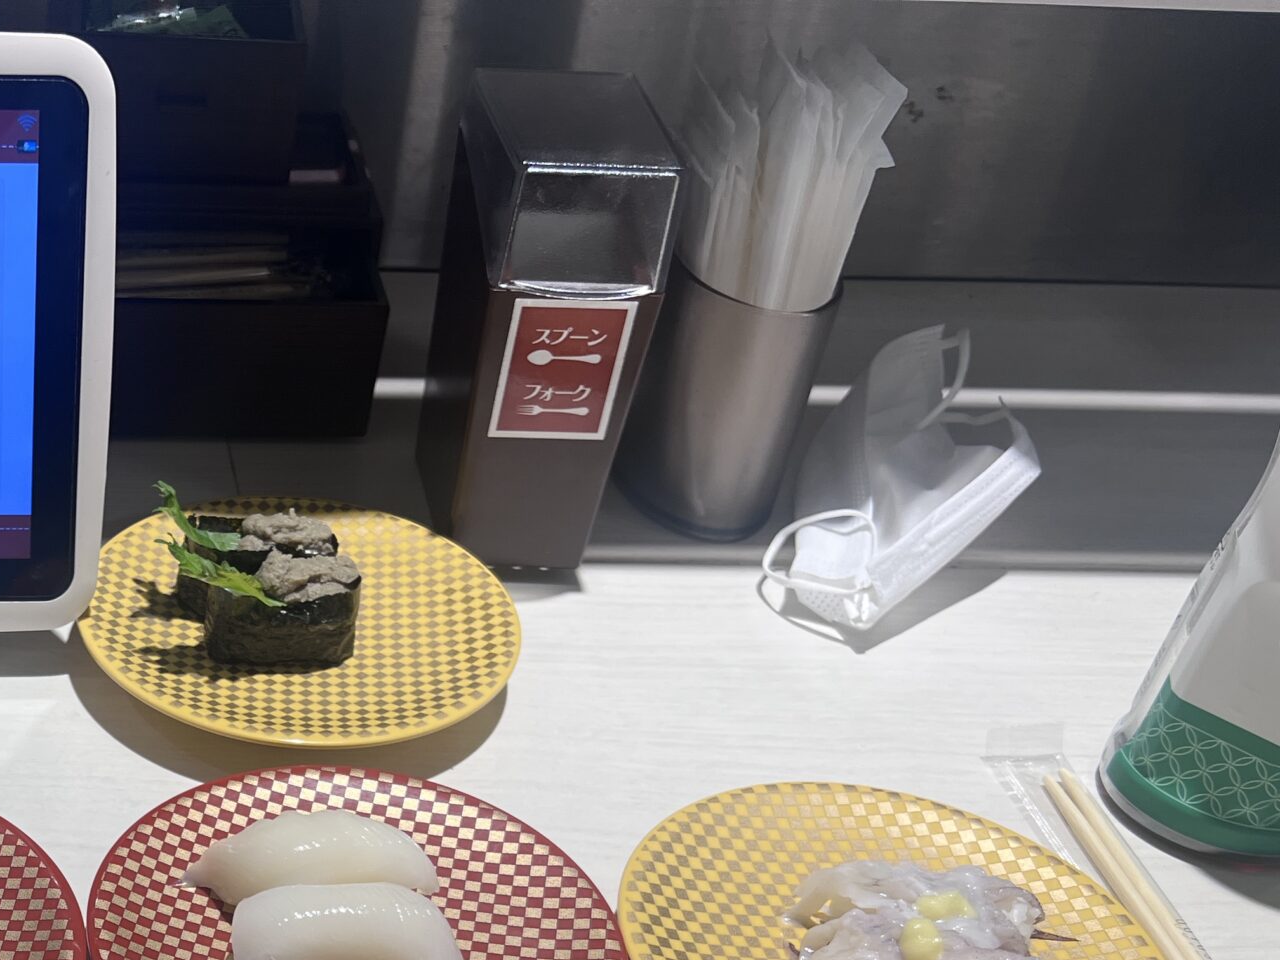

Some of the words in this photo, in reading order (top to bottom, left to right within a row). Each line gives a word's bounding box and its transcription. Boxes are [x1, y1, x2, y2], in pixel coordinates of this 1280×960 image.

[532, 327, 608, 346] スプーン
[523, 385, 592, 402] フォーク
